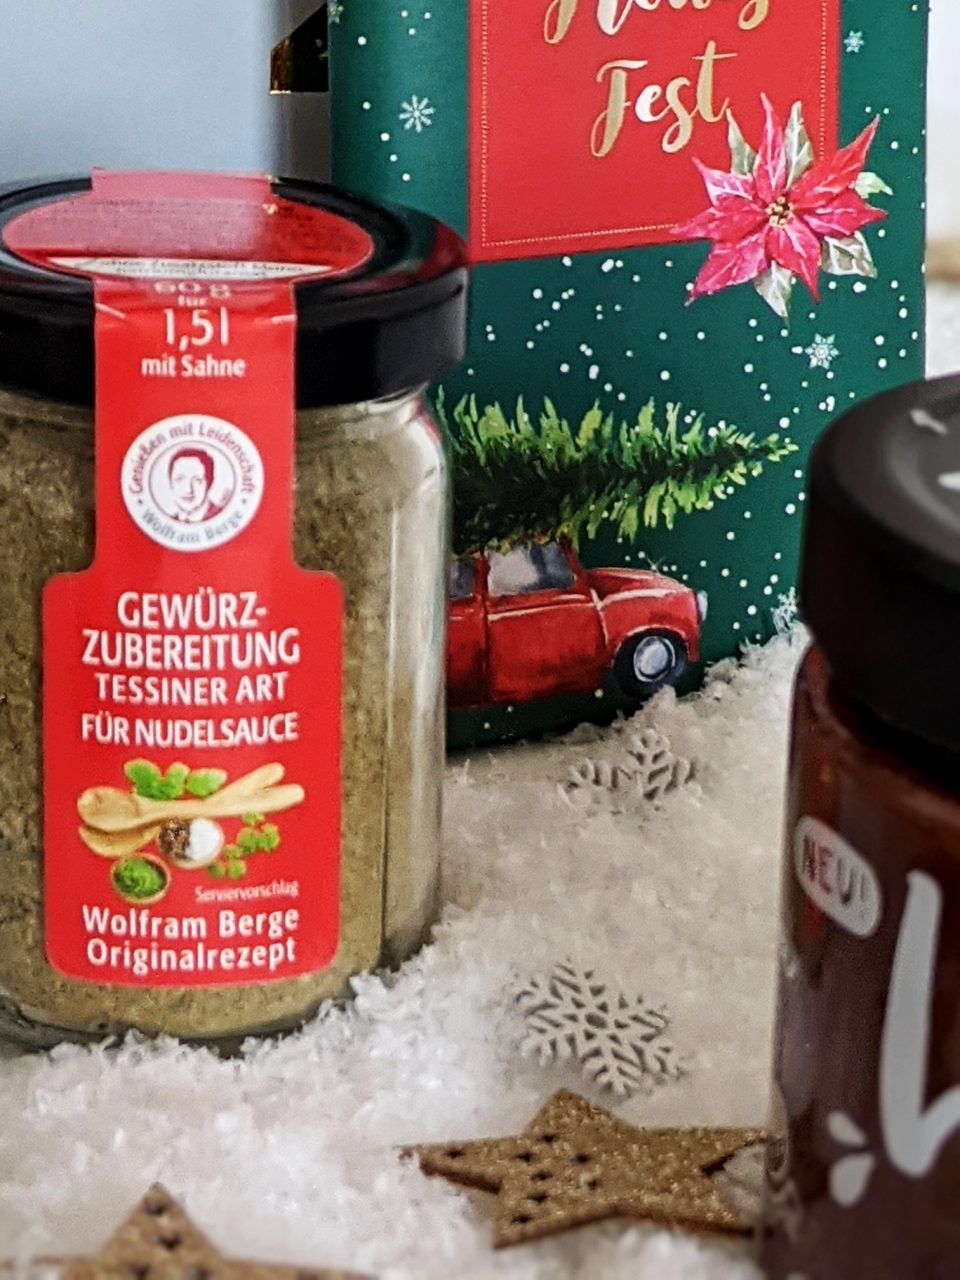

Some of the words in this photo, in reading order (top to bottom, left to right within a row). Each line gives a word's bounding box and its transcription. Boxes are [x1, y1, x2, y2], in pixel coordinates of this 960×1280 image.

[588, 41, 737, 158] Fest
[141, 353, 176, 377] mit
[181, 353, 246, 377] Sahne
[169, 421, 194, 439] mit
[199, 422, 257, 494] Leidenschaft
[117, 587, 268, 630] GEWÜRZ-
[81, 628, 301, 671] ZUBEREITUNG
[95, 672, 227, 706] TESSINER
[235, 672, 288, 703] ART
[81, 710, 129, 744] FÜR
[135, 712, 299, 747] NUDELSAUCE
[195, 880, 299, 903] Serviervorschlag
[82, 904, 206, 940] Wolfram
[219, 907, 300, 940] Berge
[86, 937, 296, 976] Originalrezept
